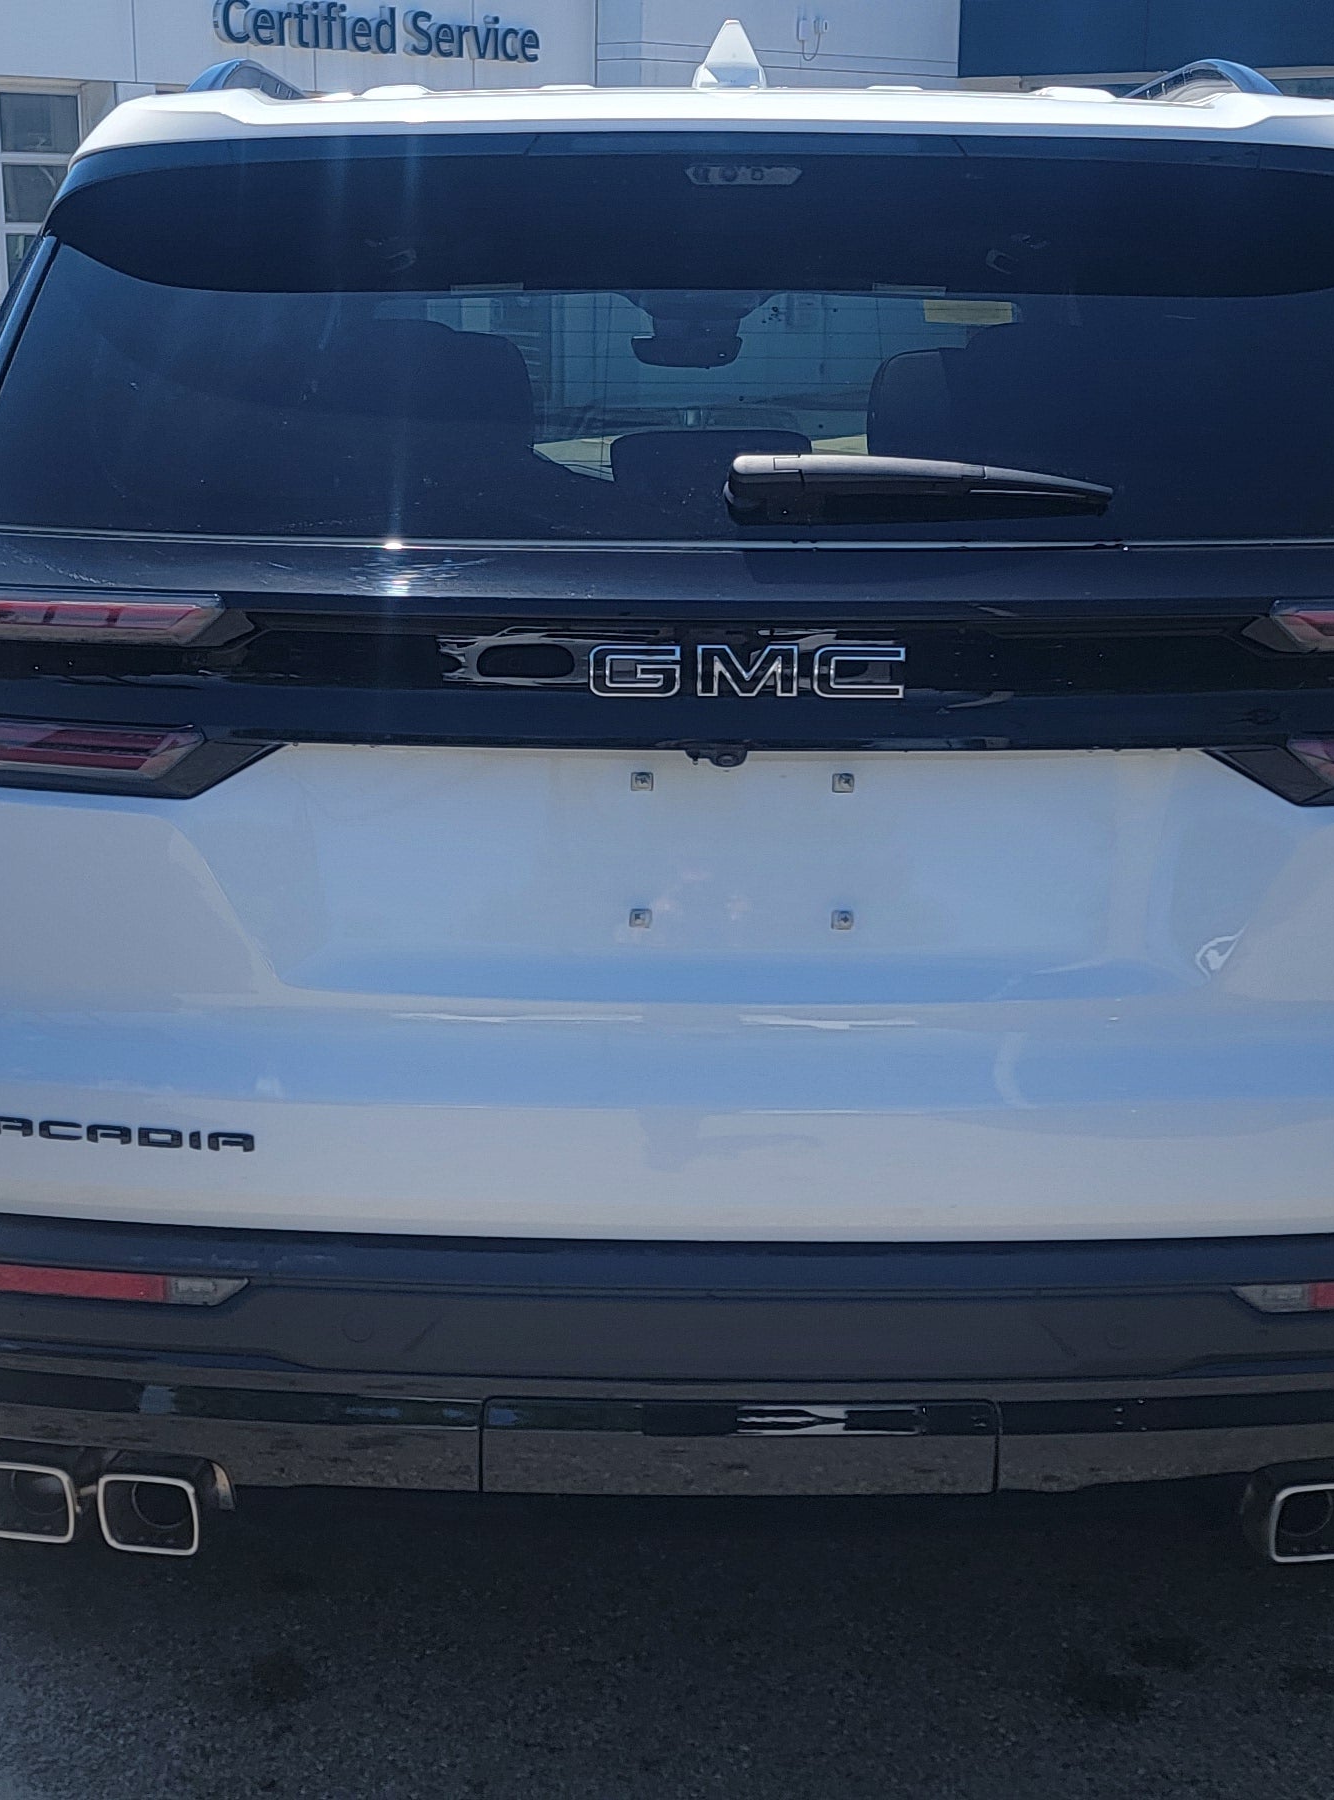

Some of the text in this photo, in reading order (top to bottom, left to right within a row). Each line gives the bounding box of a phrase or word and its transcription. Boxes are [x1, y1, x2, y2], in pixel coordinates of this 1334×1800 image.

[217, 0, 540, 63] Certified Service
[589, 645, 906, 698] GMC
